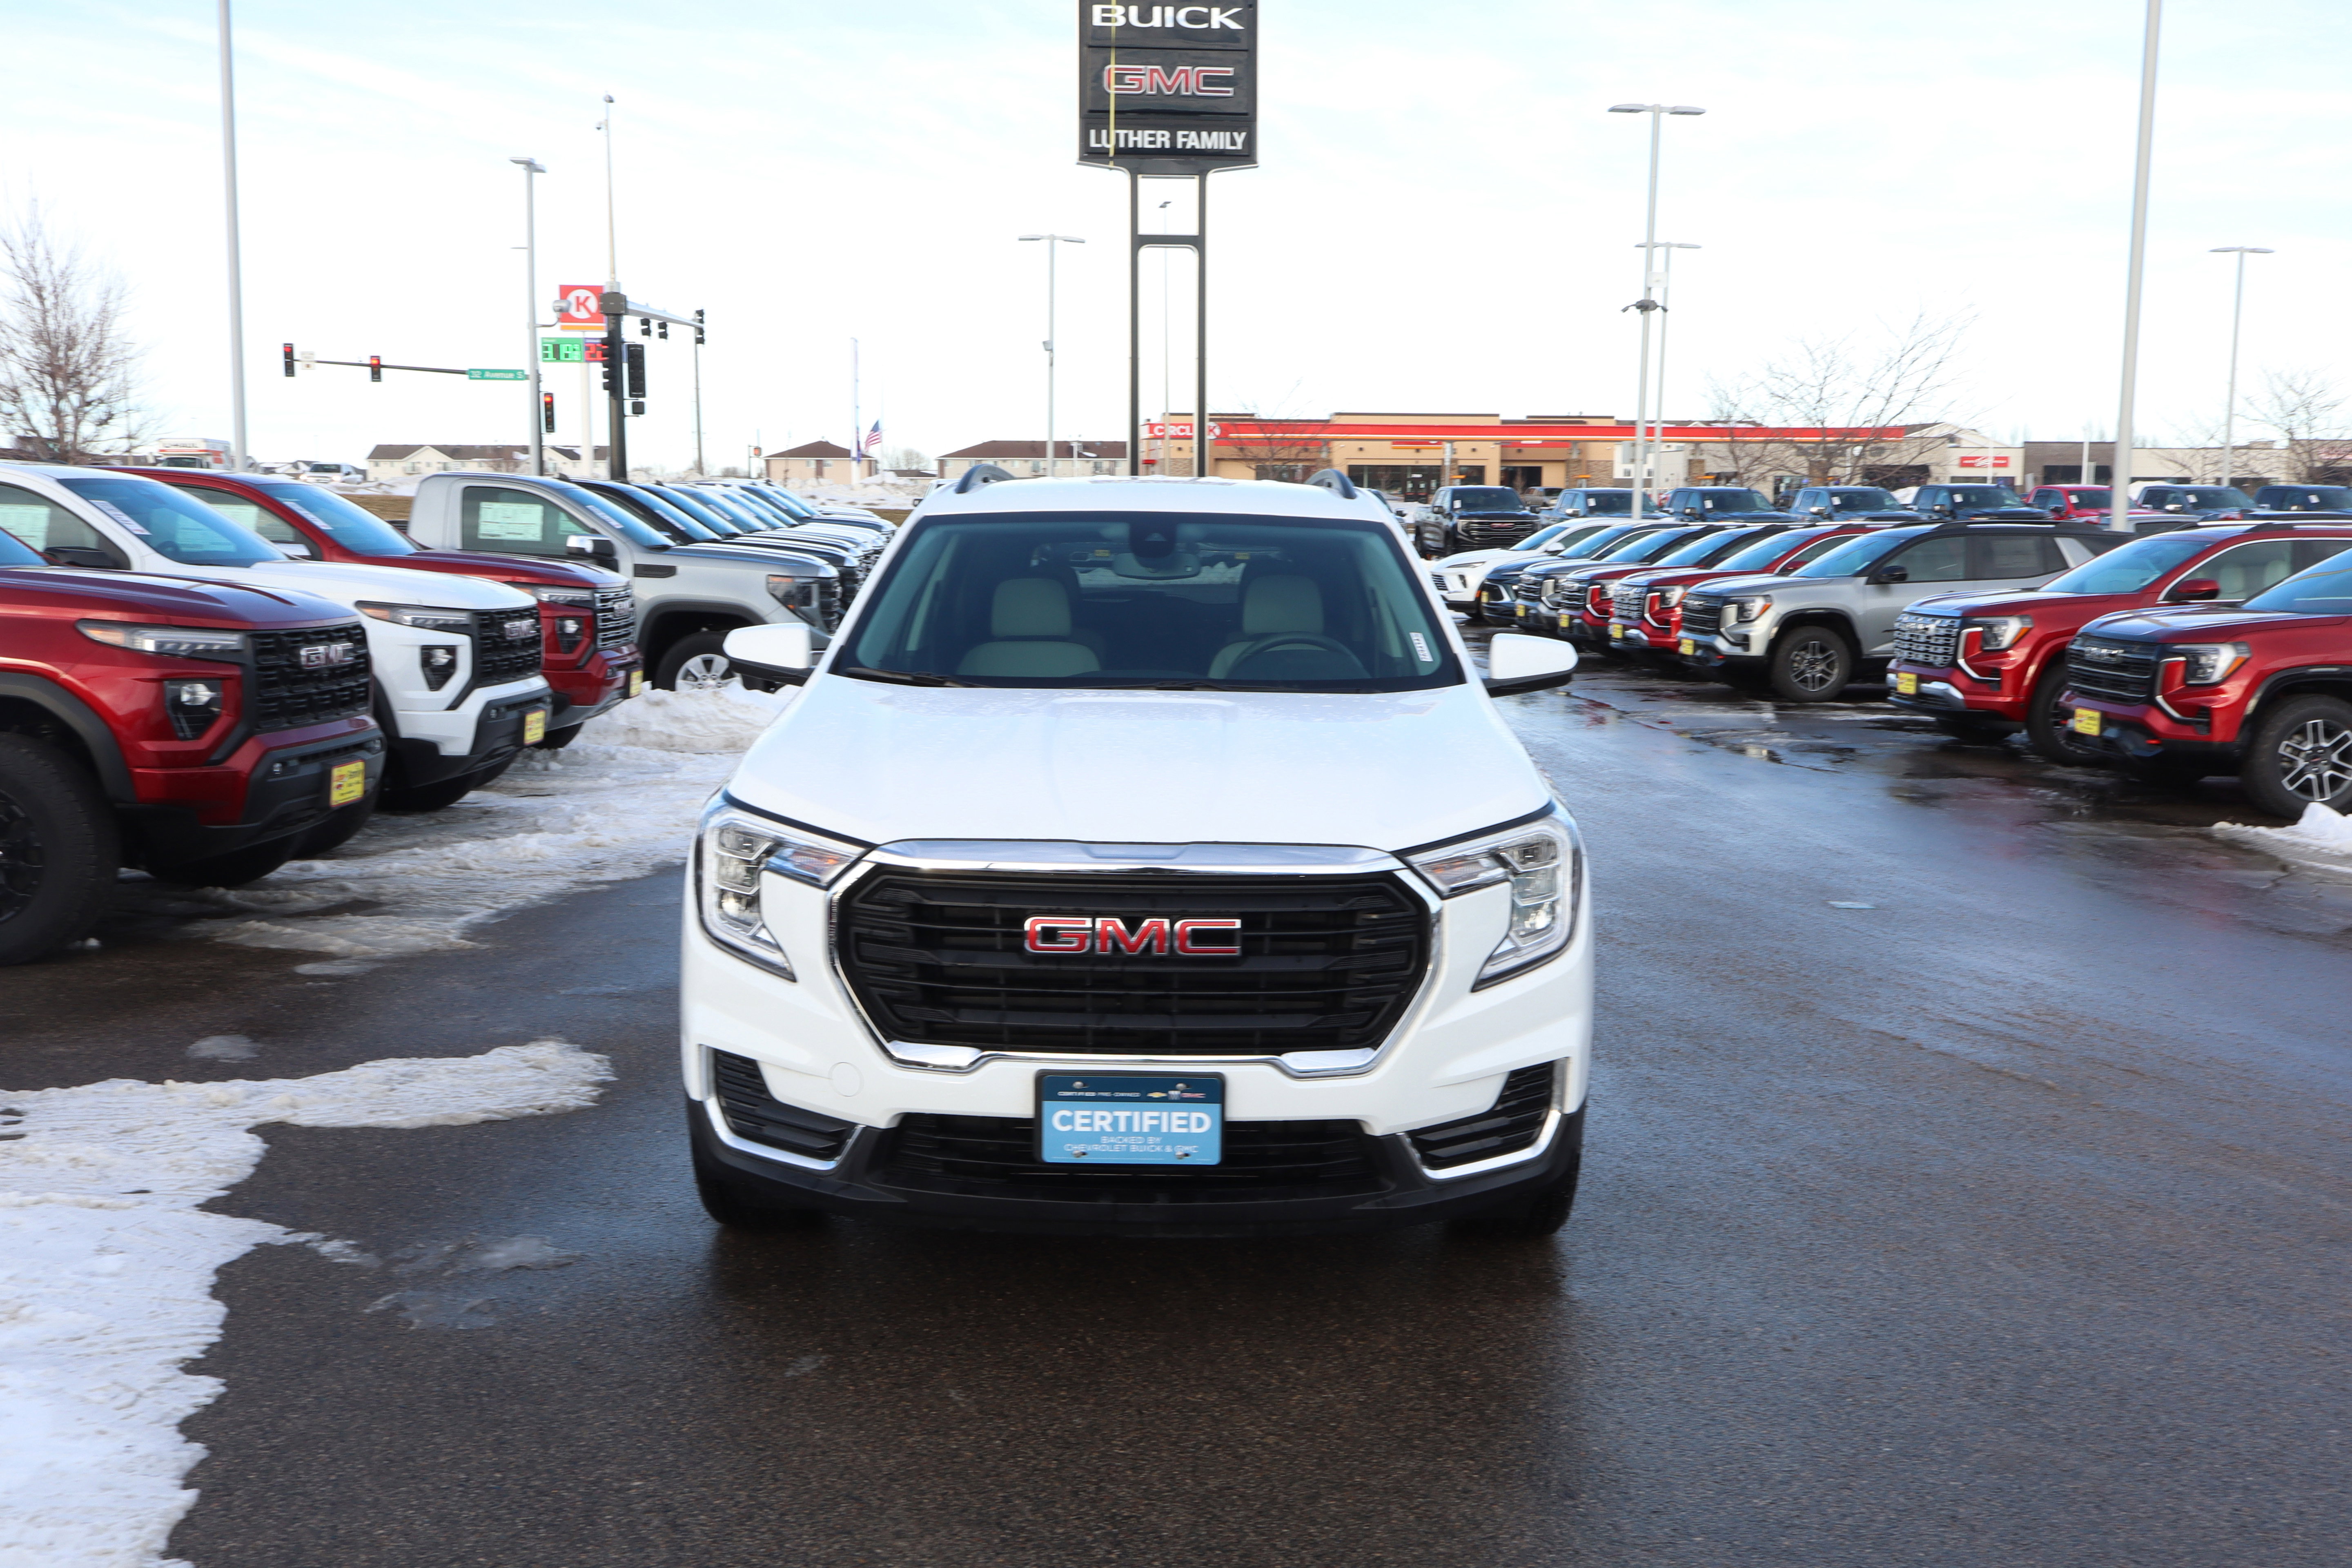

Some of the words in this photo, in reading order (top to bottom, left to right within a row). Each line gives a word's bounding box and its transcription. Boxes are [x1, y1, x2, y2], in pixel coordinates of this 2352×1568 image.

[1091, 4, 1245, 29] BUICK
[1104, 65, 1235, 97] GMC
[1089, 129, 1171, 149] LUTHER
[1176, 131, 1247, 150] FAMILY
[575, 295, 593, 317] K
[1024, 915, 1242, 956] GMC
[1051, 1110, 1212, 1134] CERTIFIED
[1064, 1144, 1127, 1152] CHEVROLET
[1130, 1145, 1163, 1153] BUICK
